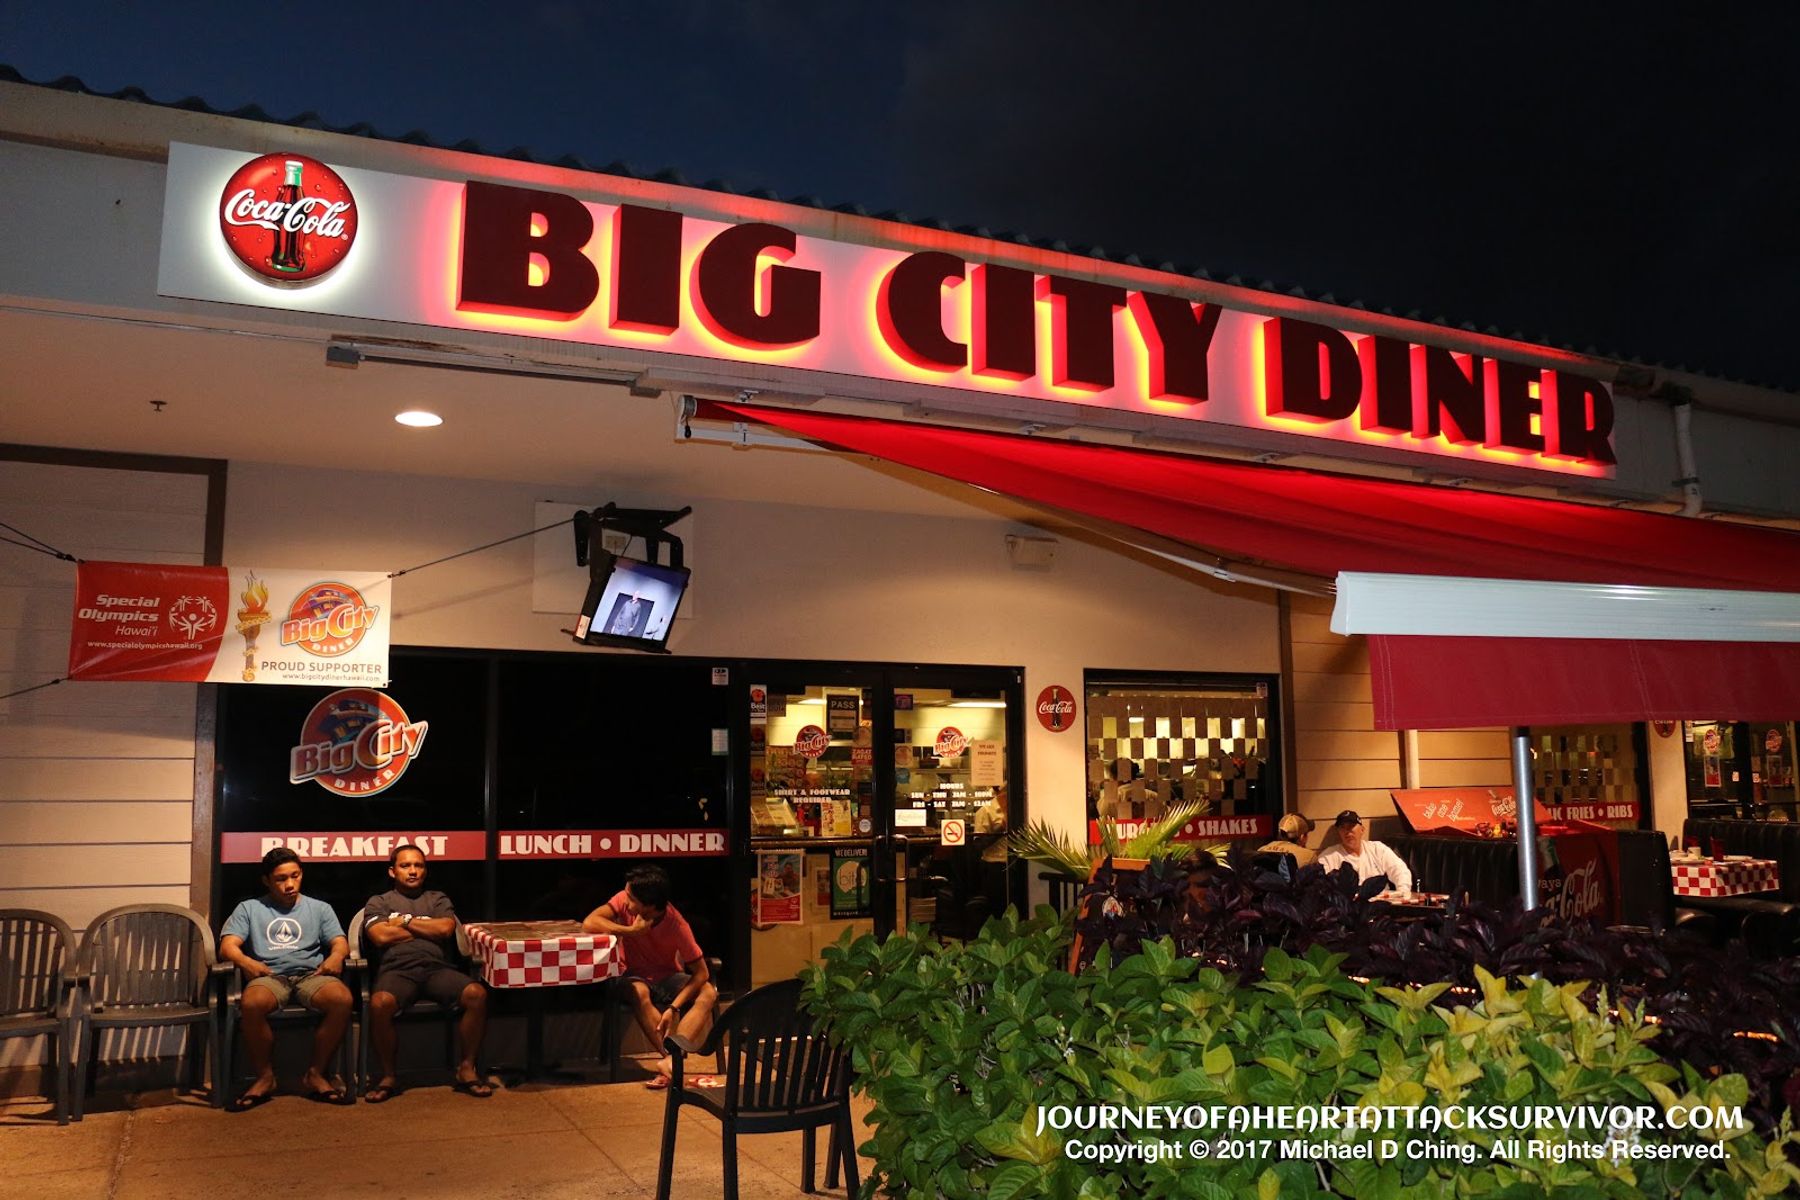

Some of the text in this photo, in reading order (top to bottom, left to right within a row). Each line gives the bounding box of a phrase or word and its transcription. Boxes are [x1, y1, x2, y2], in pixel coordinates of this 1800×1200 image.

[225, 188, 351, 238] Coca-Cola
[457, 180, 1617, 466] BIG CITY DINER
[96, 594, 160, 607] Special
[78, 608, 159, 623] Olympics
[312, 638, 354, 653] DINER
[261, 661, 382, 674] PROUD SUPPORTER
[831, 700, 855, 709] PASS
[334, 769, 395, 791] DINER
[810, 788, 851, 796] FOOTWEAR
[1566, 806, 1594, 820] FRIES
[1607, 804, 1633, 819] RIBS
[1198, 818, 1258, 837] SHAKES
[500, 834, 592, 855] LUNCH
[620, 832, 724, 853] DINNER
